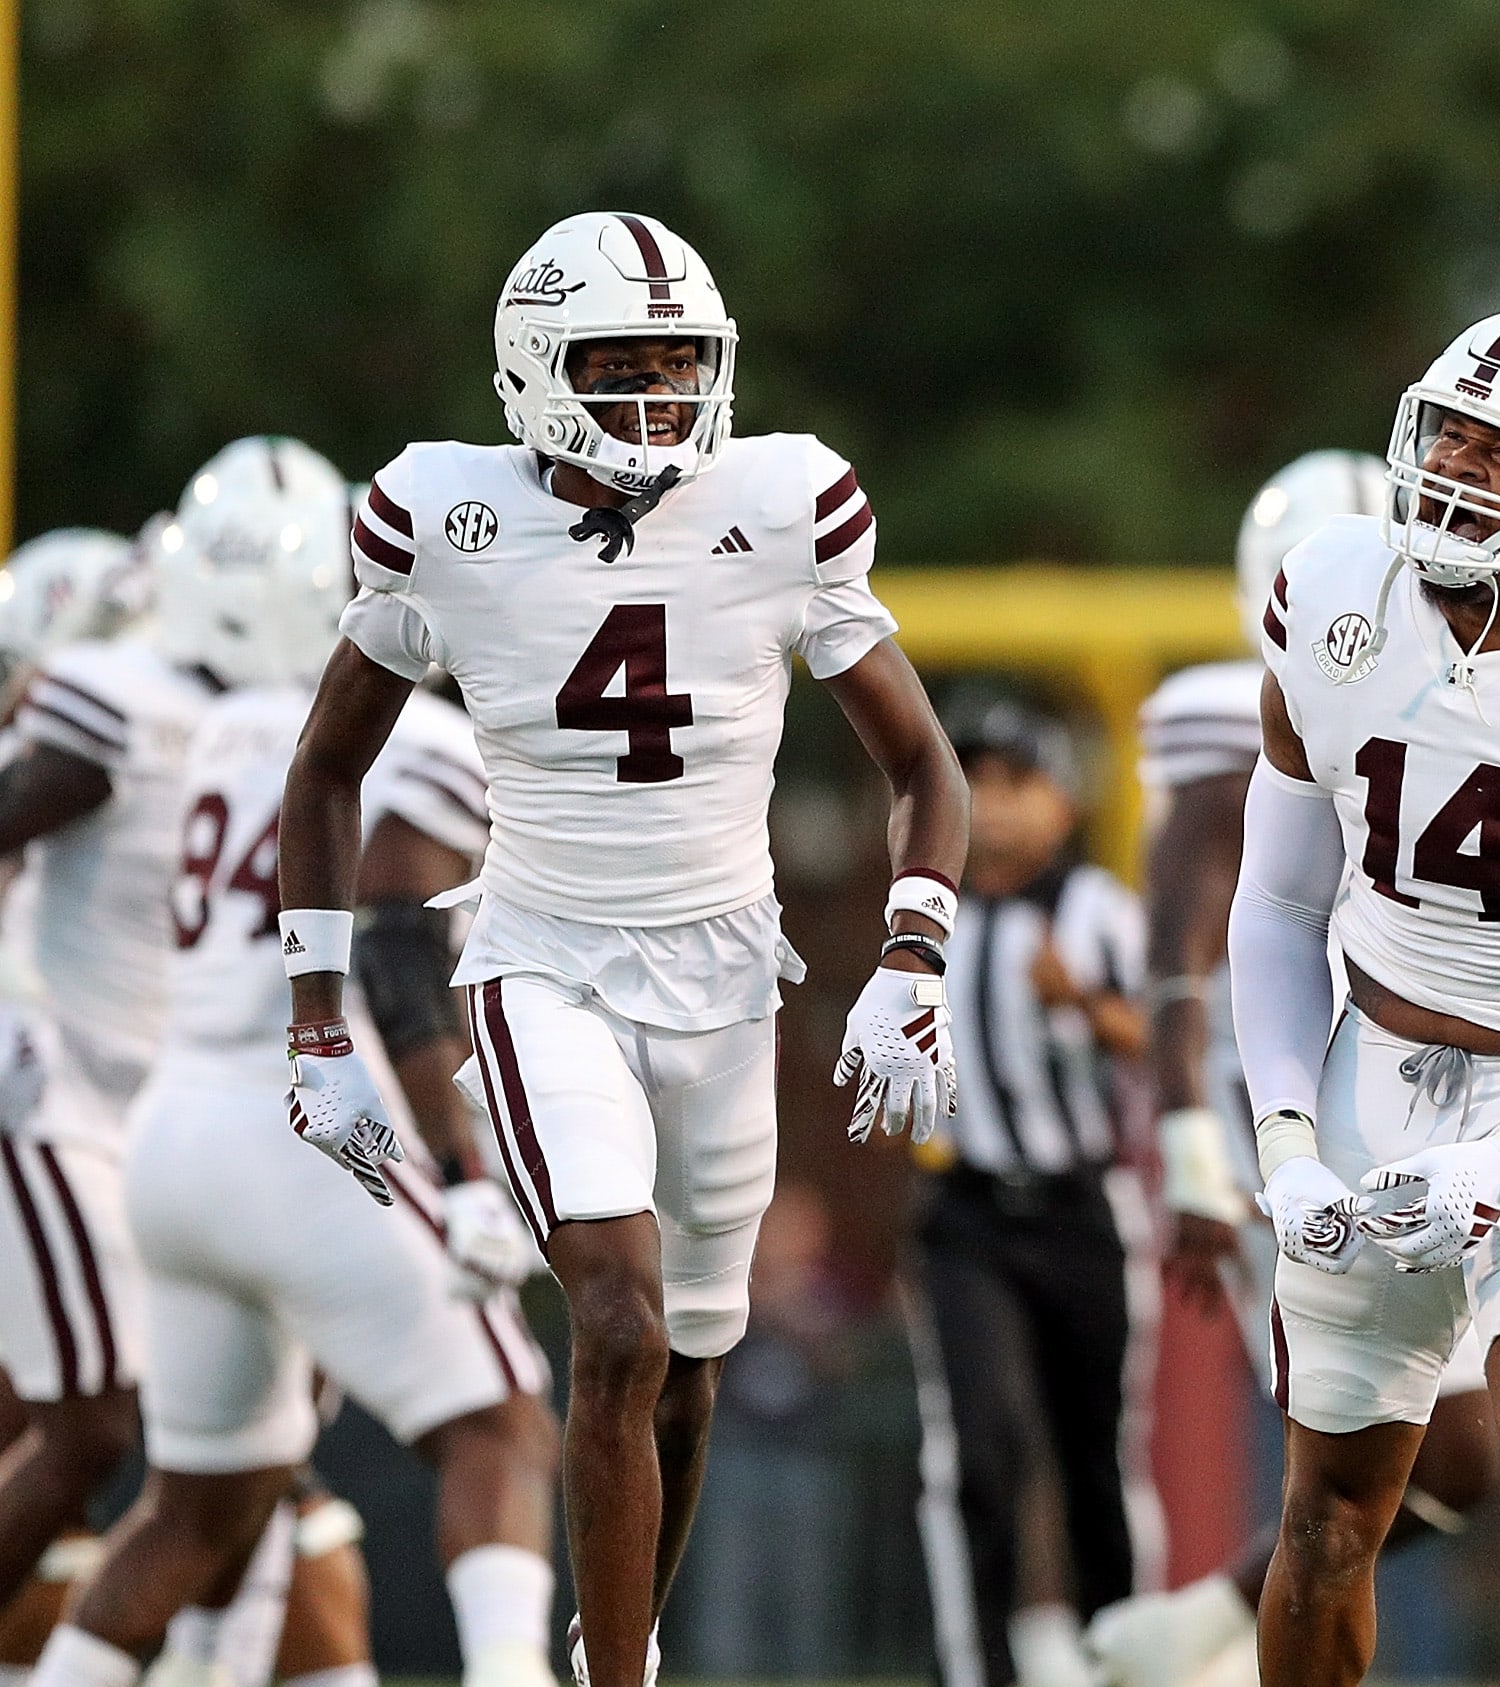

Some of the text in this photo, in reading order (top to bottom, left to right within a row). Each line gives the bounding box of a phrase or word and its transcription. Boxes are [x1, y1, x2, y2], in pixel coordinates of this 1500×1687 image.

[446, 502, 497, 551] SEC
[556, 604, 693, 783] 4
[921, 901, 949, 920] adidas
